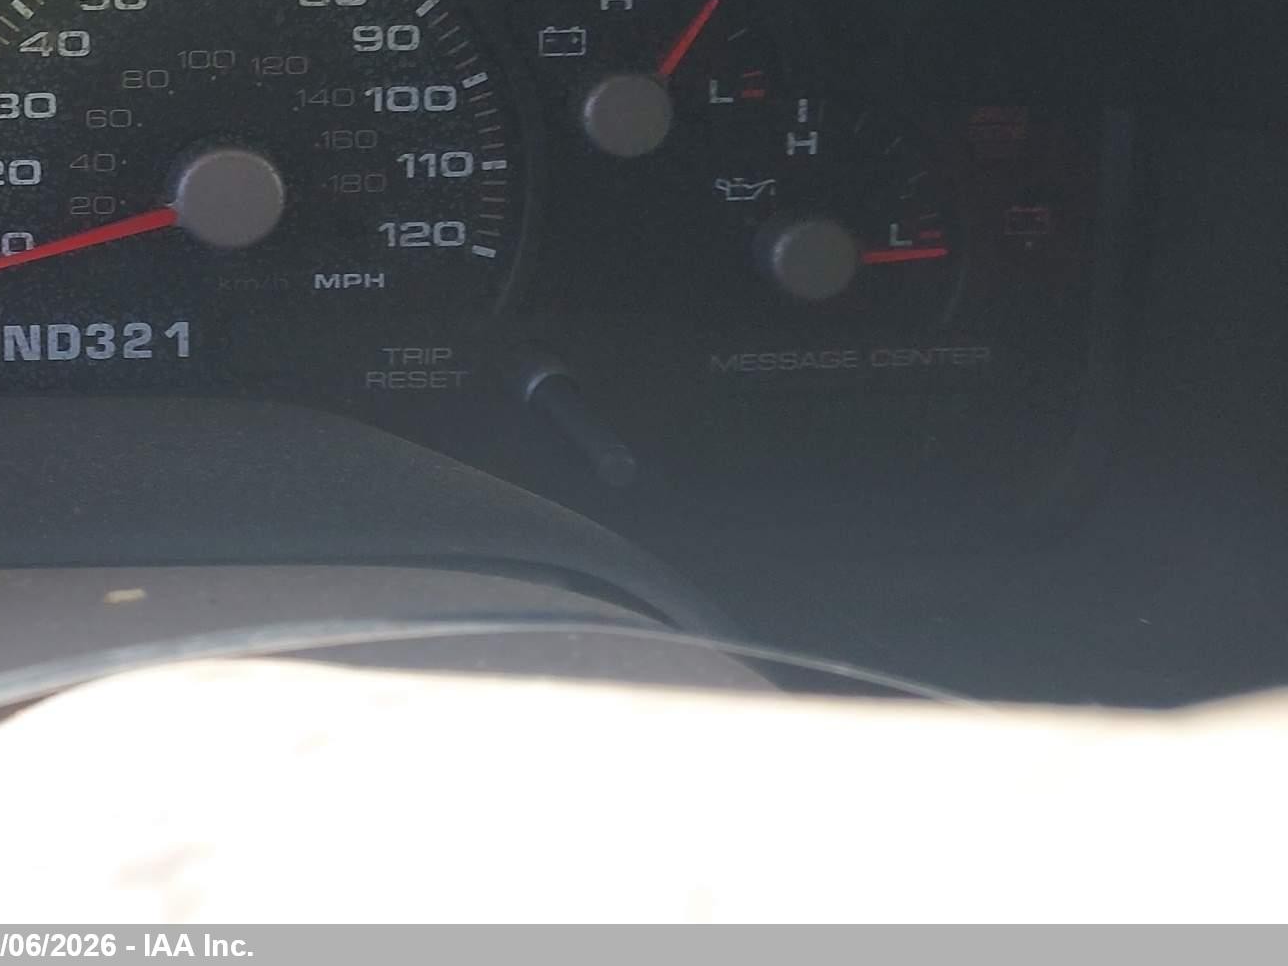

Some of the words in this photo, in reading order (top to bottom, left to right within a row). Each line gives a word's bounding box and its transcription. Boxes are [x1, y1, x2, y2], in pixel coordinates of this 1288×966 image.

[19, 31, 89, 56] 40
[353, 25, 419, 51] 90
[178, 50, 235, 68] 100
[251, 56, 308, 74] 120
[122, 70, 169, 89] 80
[298, 88, 355, 106] 140
[365, 86, 456, 111] 100
[710, 80, 733, 103] L
[86, 109, 131, 128] 60
[322, 130, 377, 149] 160
[787, 132, 817, 155] H
[70, 154, 115, 171] 40
[397, 152, 473, 178] 110
[329, 172, 386, 193] 180
[70, 196, 115, 214] 20
[379, 221, 465, 246] 120
[890, 224, 912, 246] L
[315, 273, 384, 288] MPH
[382, 348, 452, 364] TRIP
[711, 351, 857, 371] MESSAGE
[870, 347, 990, 367] CENTER
[366, 371, 467, 388] RESET
